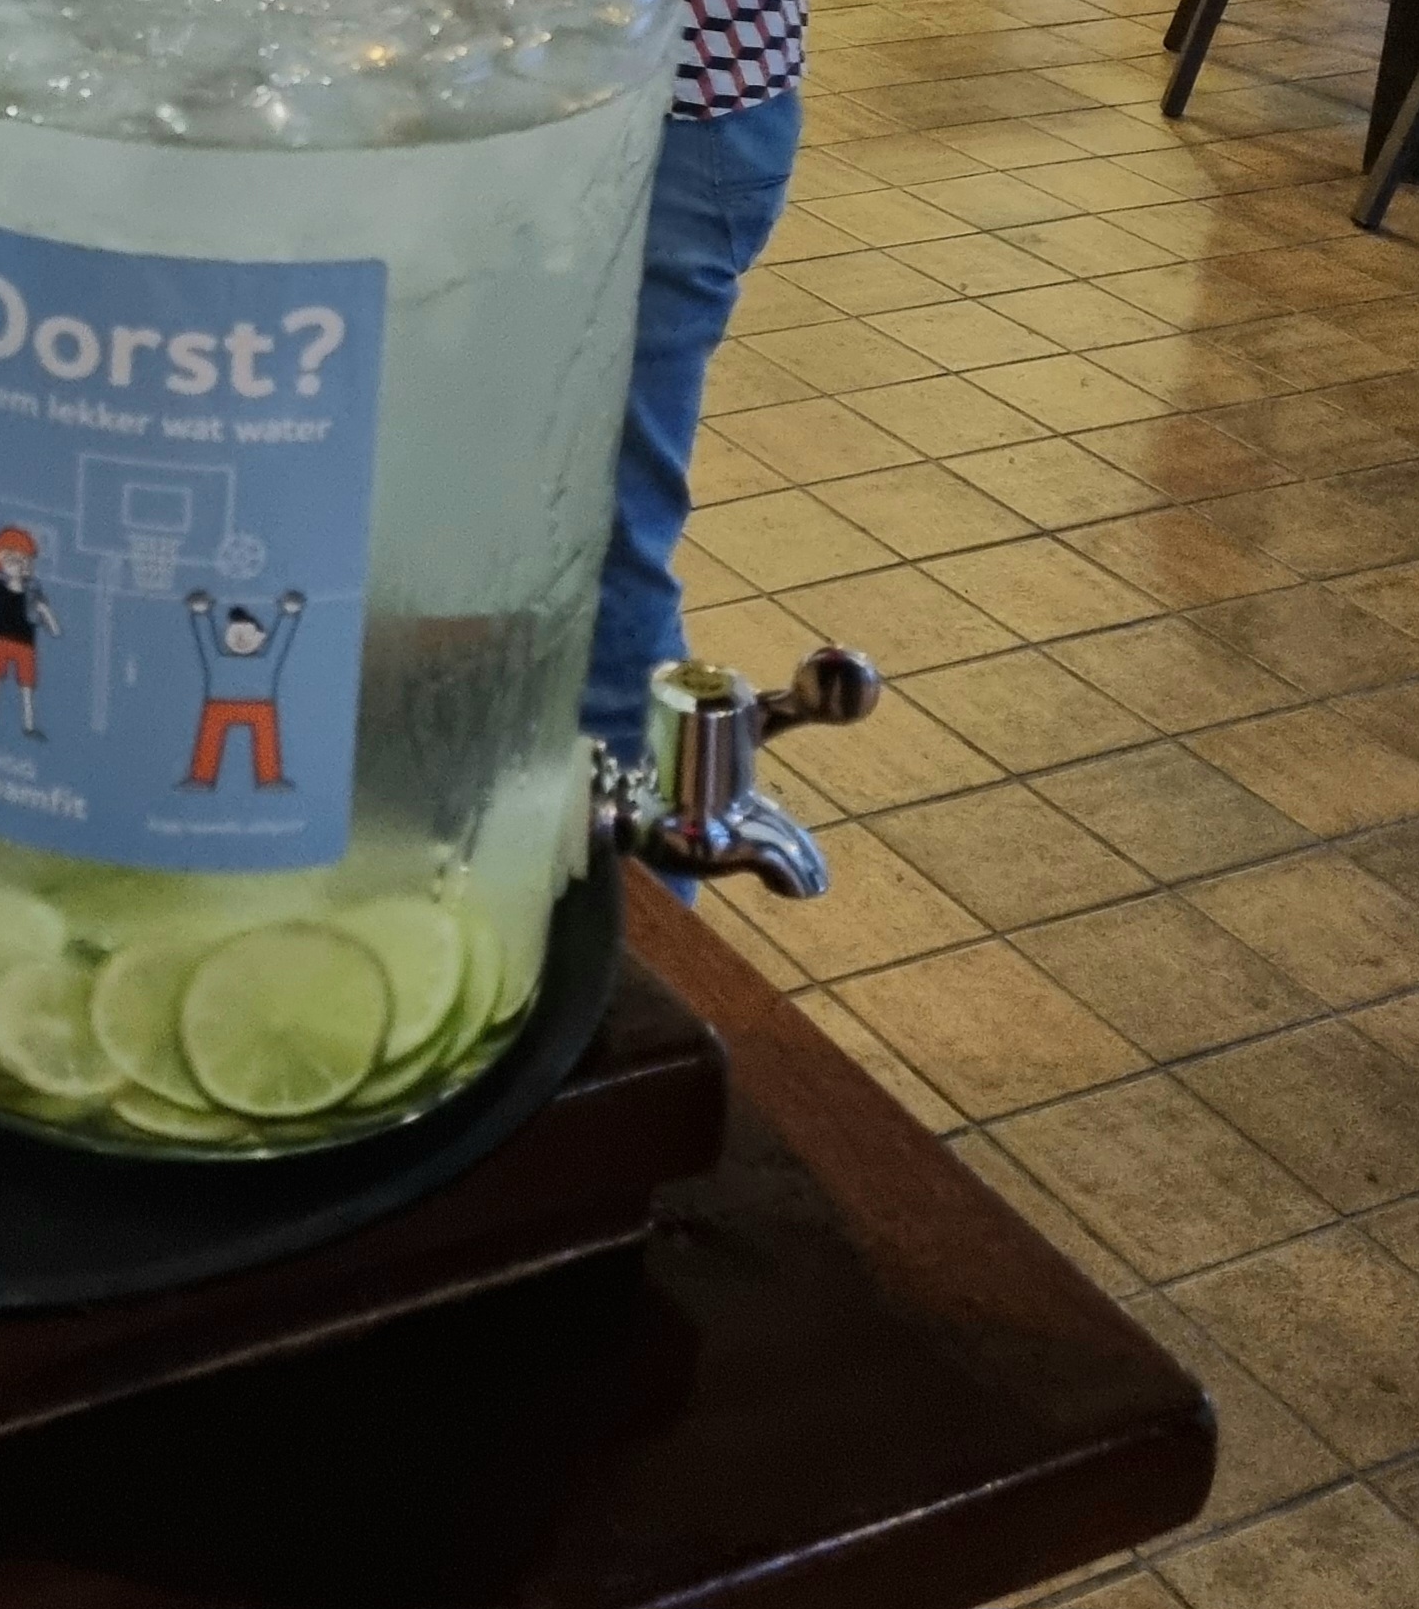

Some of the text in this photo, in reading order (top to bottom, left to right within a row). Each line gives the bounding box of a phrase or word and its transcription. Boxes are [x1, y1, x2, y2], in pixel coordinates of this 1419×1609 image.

[46, 394, 150, 436] lekker
[161, 414, 224, 442] wat
[232, 415, 334, 444] water
